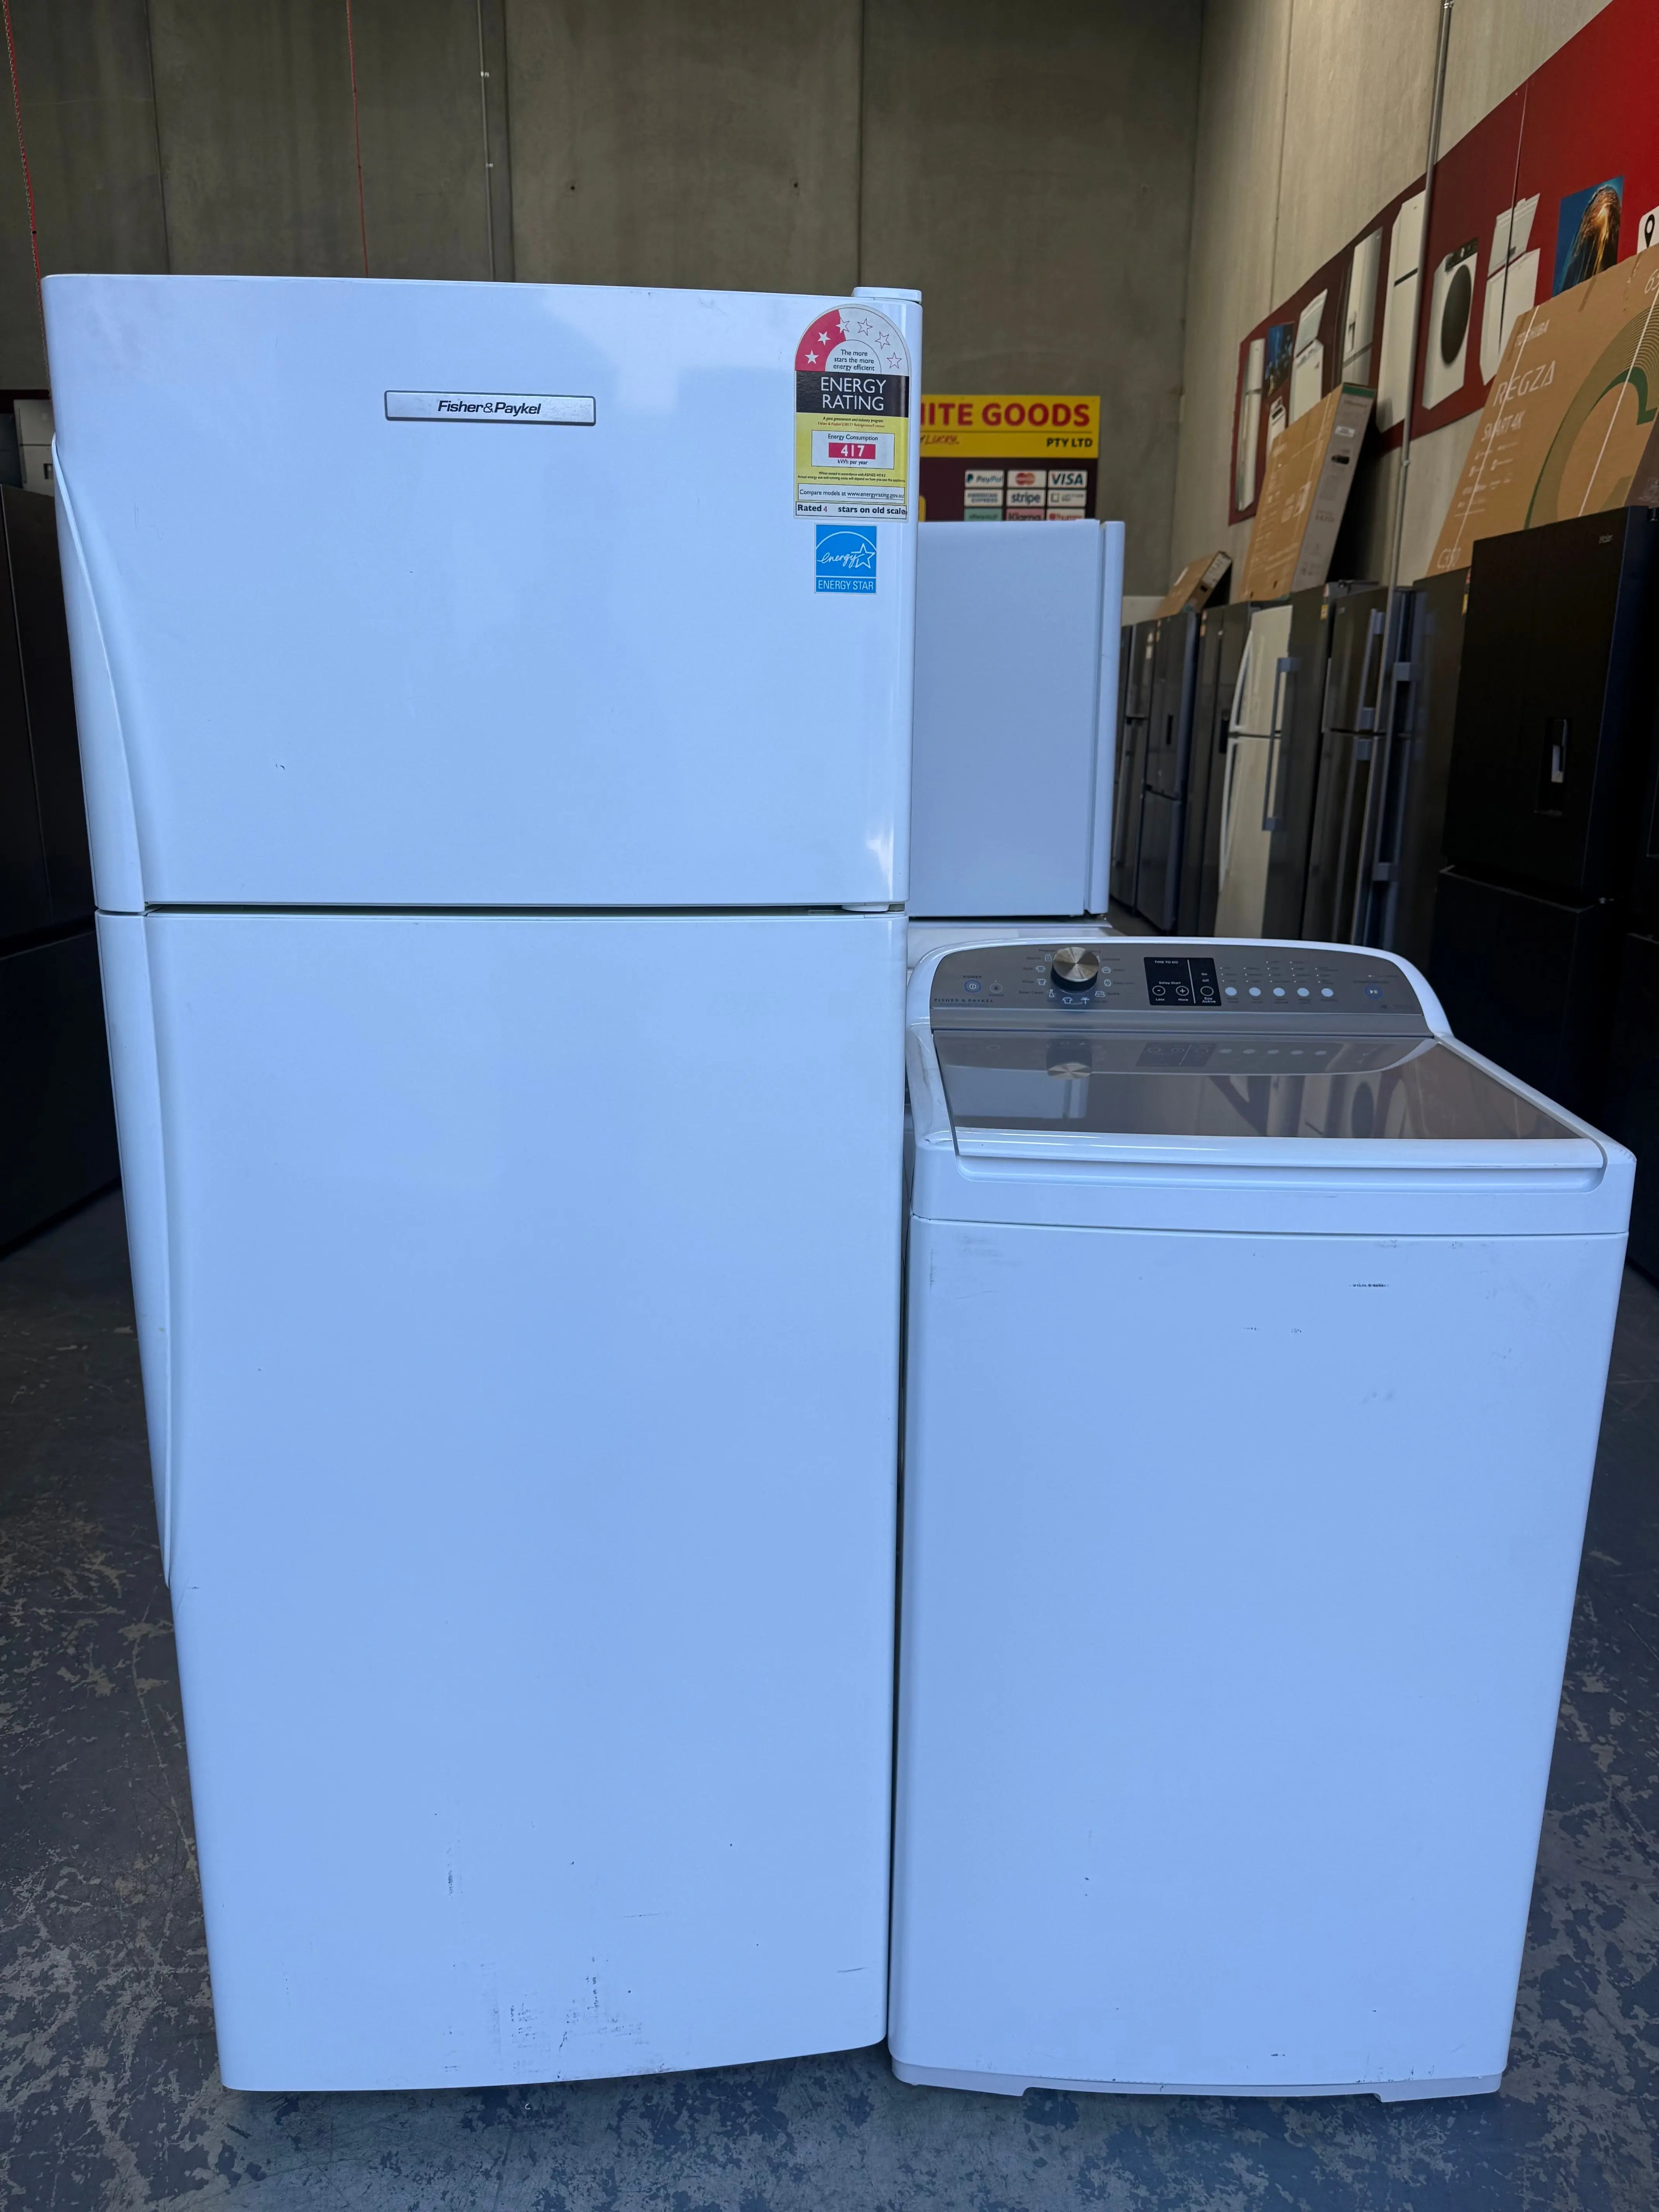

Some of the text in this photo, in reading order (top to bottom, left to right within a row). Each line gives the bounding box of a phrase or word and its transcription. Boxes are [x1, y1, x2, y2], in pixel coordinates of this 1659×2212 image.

[821, 377, 886, 394] ENERGY
[823, 395, 884, 411] RATING
[921, 403, 1090, 427] ITE GOODS
[1046, 437, 1093, 448] PTY LTD
[841, 445, 865, 457] 417
[1051, 473, 1083, 485] VISA
[1011, 492, 1041, 504] stripe
[817, 552, 857, 568] energy
[819, 580, 873, 590] ENERGY STAR
